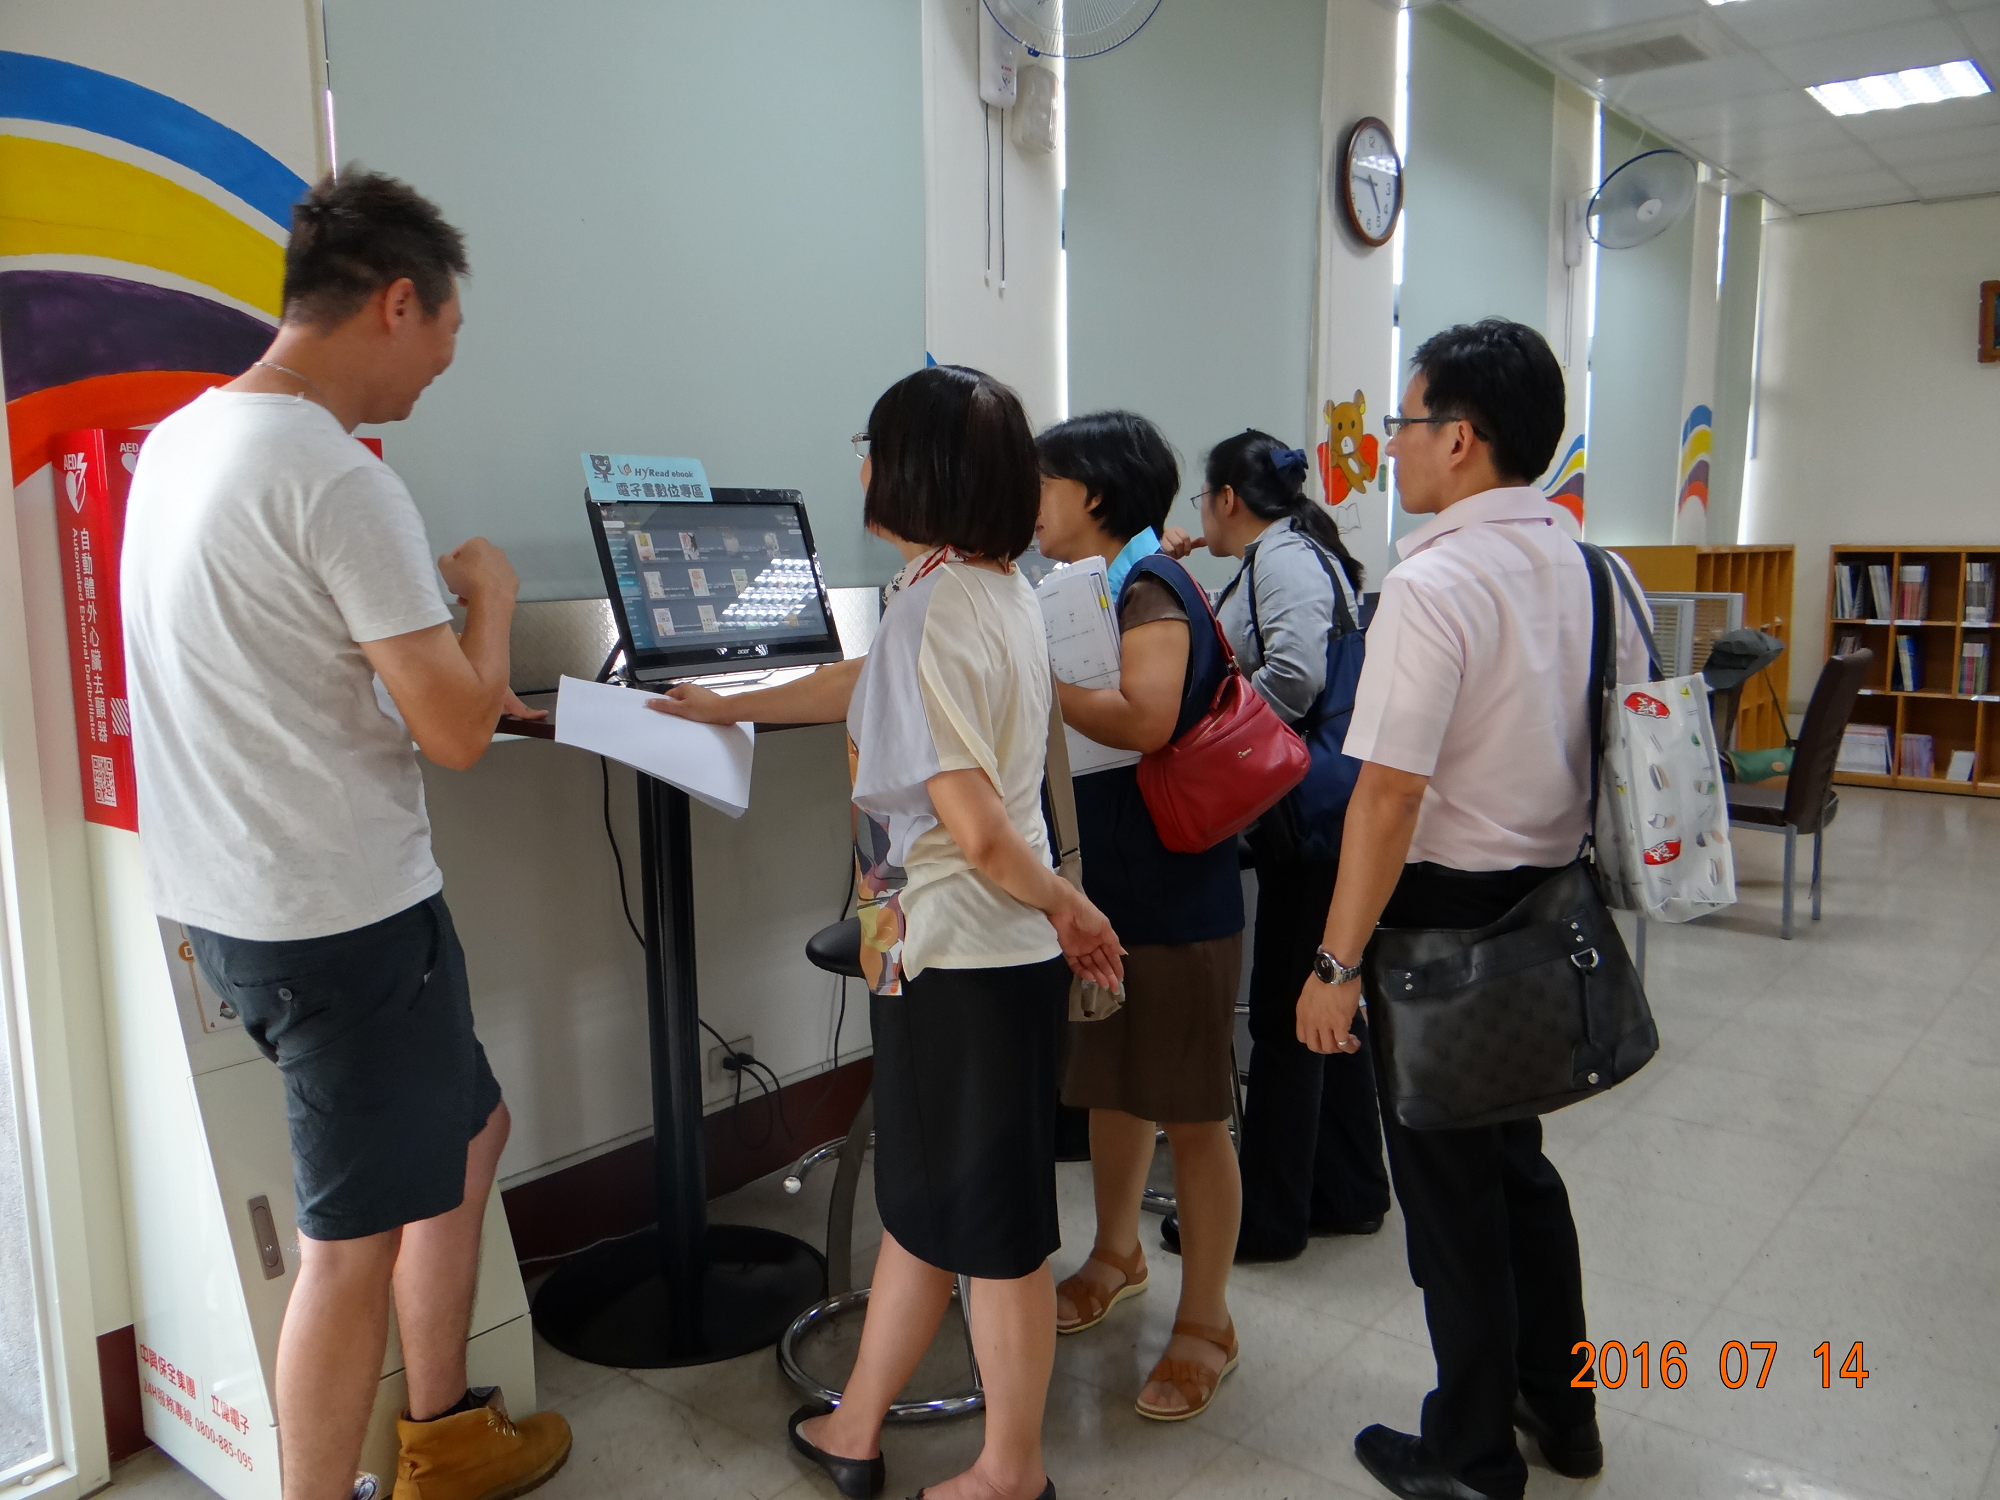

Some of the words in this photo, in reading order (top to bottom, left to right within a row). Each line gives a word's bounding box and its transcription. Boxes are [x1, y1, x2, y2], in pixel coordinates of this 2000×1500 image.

[63, 453, 77, 471] AED
[119, 442, 139, 453] AED
[615, 482, 705, 498] 電子書數位專區
[671, 470, 695, 479] ebook
[72, 527, 85, 602] Automated
[79, 605, 90, 660] External
[84, 664, 97, 742] Defibrillator
[194, 1417, 253, 1472] 0800-885-095
